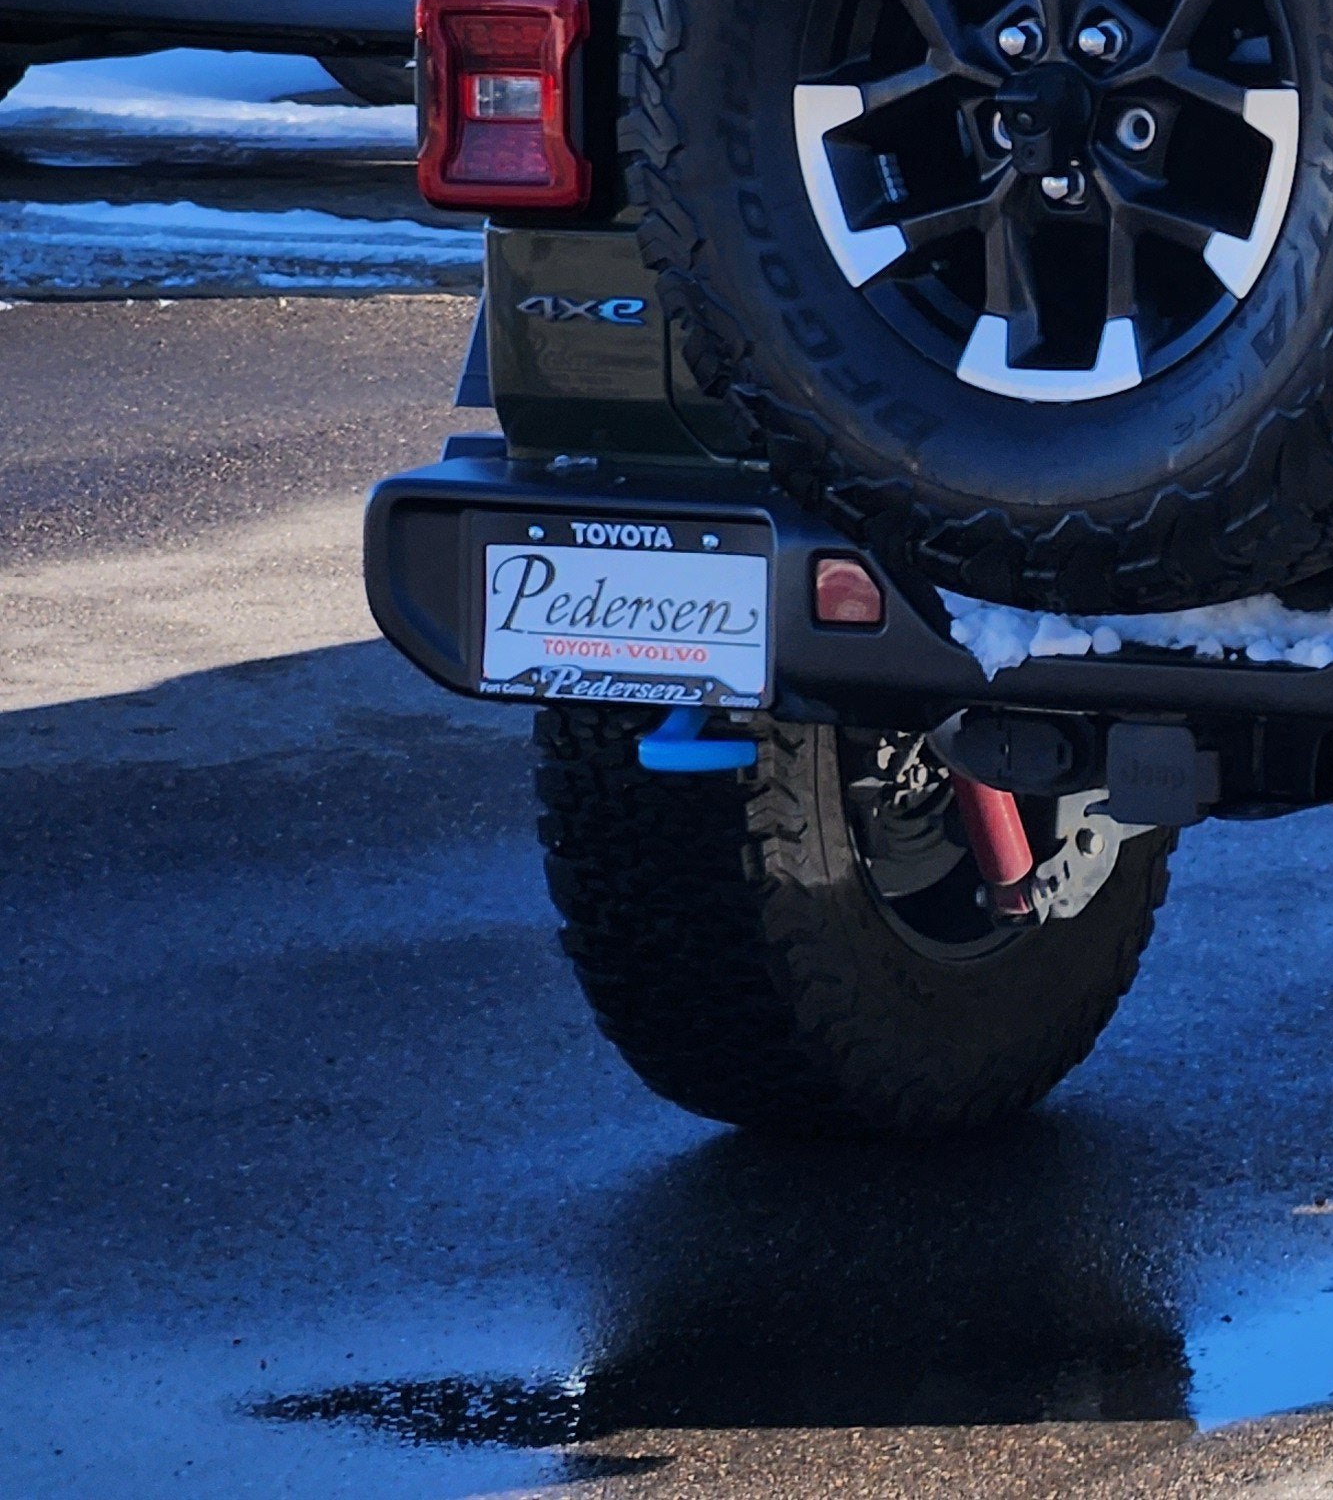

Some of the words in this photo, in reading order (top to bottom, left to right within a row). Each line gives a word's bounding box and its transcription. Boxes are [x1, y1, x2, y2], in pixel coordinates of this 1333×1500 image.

[570, 522, 674, 549] TOYOTA
[492, 553, 760, 635] Pedersen
[543, 638, 612, 658] TOYOTA
[626, 643, 708, 663] VOLVO
[541, 663, 703, 702] Pedersen
